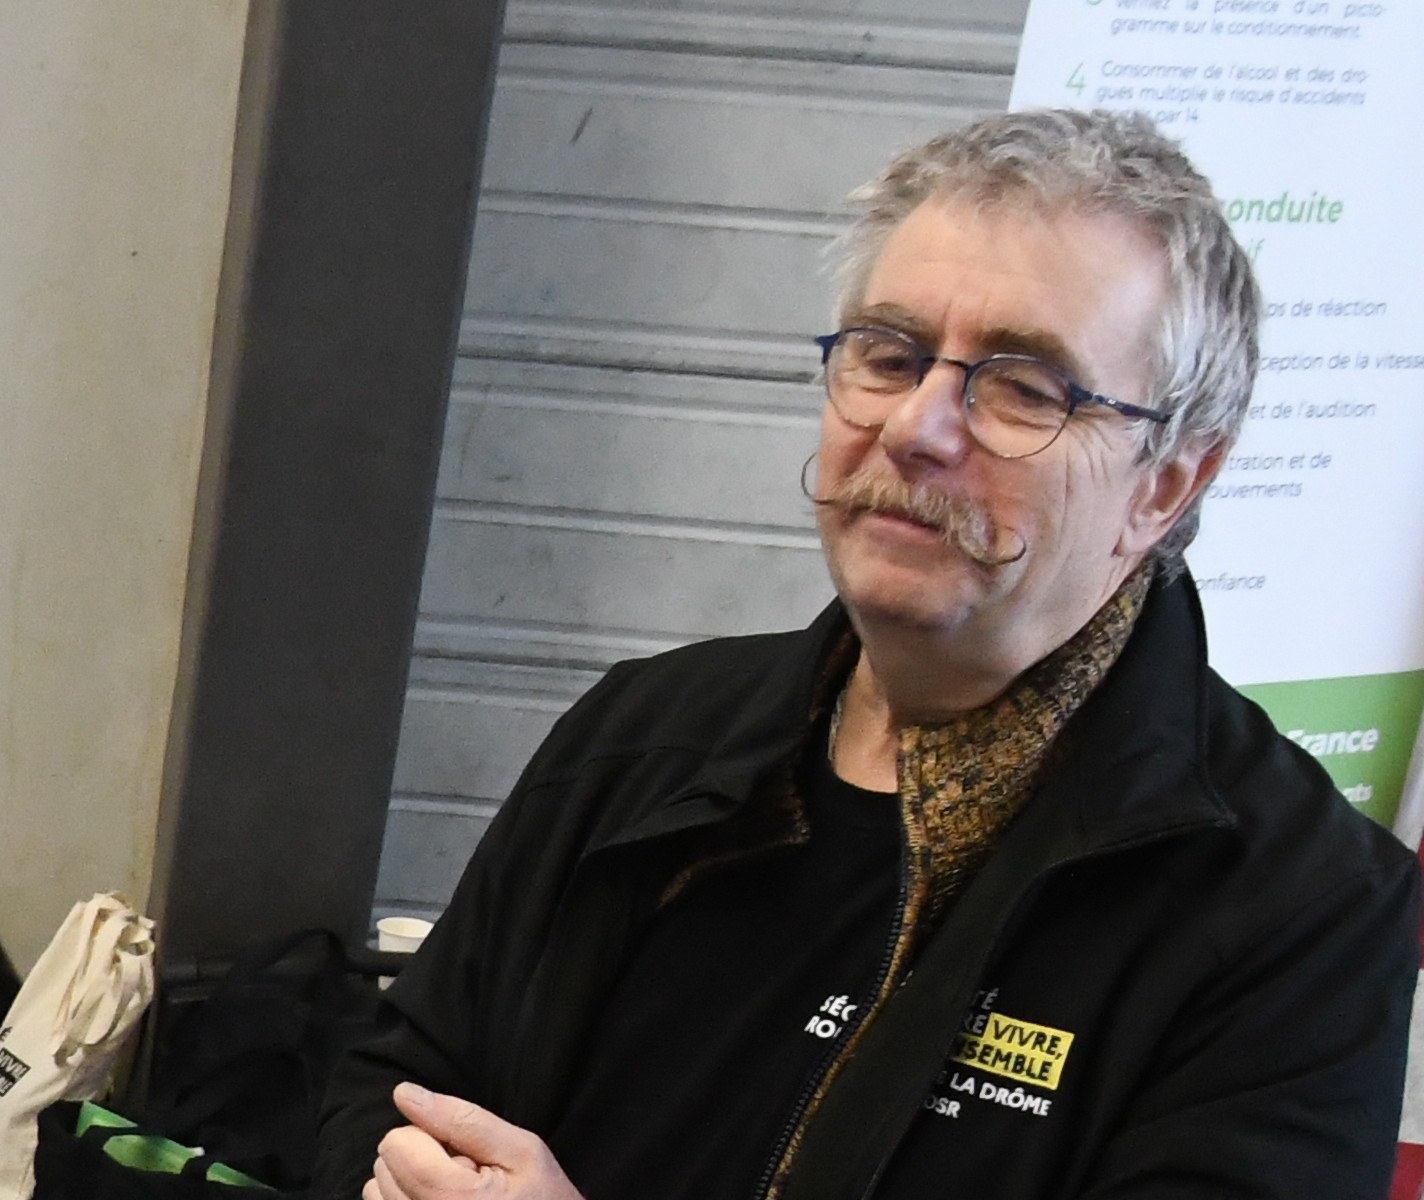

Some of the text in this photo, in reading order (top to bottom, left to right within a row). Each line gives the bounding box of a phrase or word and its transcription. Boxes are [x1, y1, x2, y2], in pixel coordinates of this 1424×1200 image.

[1110, 18, 1180, 36] gramme
[1184, 20, 1207, 34] sur
[1211, 18, 1224, 35] le
[1065, 62, 1087, 97] 4
[1101, 60, 1199, 78] Consommer
[1203, 65, 1223, 79] de
[1284, 67, 1301, 82] et
[1307, 66, 1335, 83] des
[1139, 86, 1207, 103] multiplie
[1213, 87, 1226, 103] le
[1230, 89, 1274, 105] risque
[1290, 299, 1312, 317] de
[1317, 298, 1387, 318] réaction
[1327, 351, 1351, 370] de
[1355, 350, 1370, 370] la
[1270, 402, 1293, 419] de
[1289, 454, 1306, 470] et
[1310, 451, 1333, 469] de
[804, 1015, 842, 1039] RO
[993, 1018, 1064, 1061] VIVRE,
[950, 1072, 975, 1095] LA
[979, 1087, 1053, 1117] DRÔME
